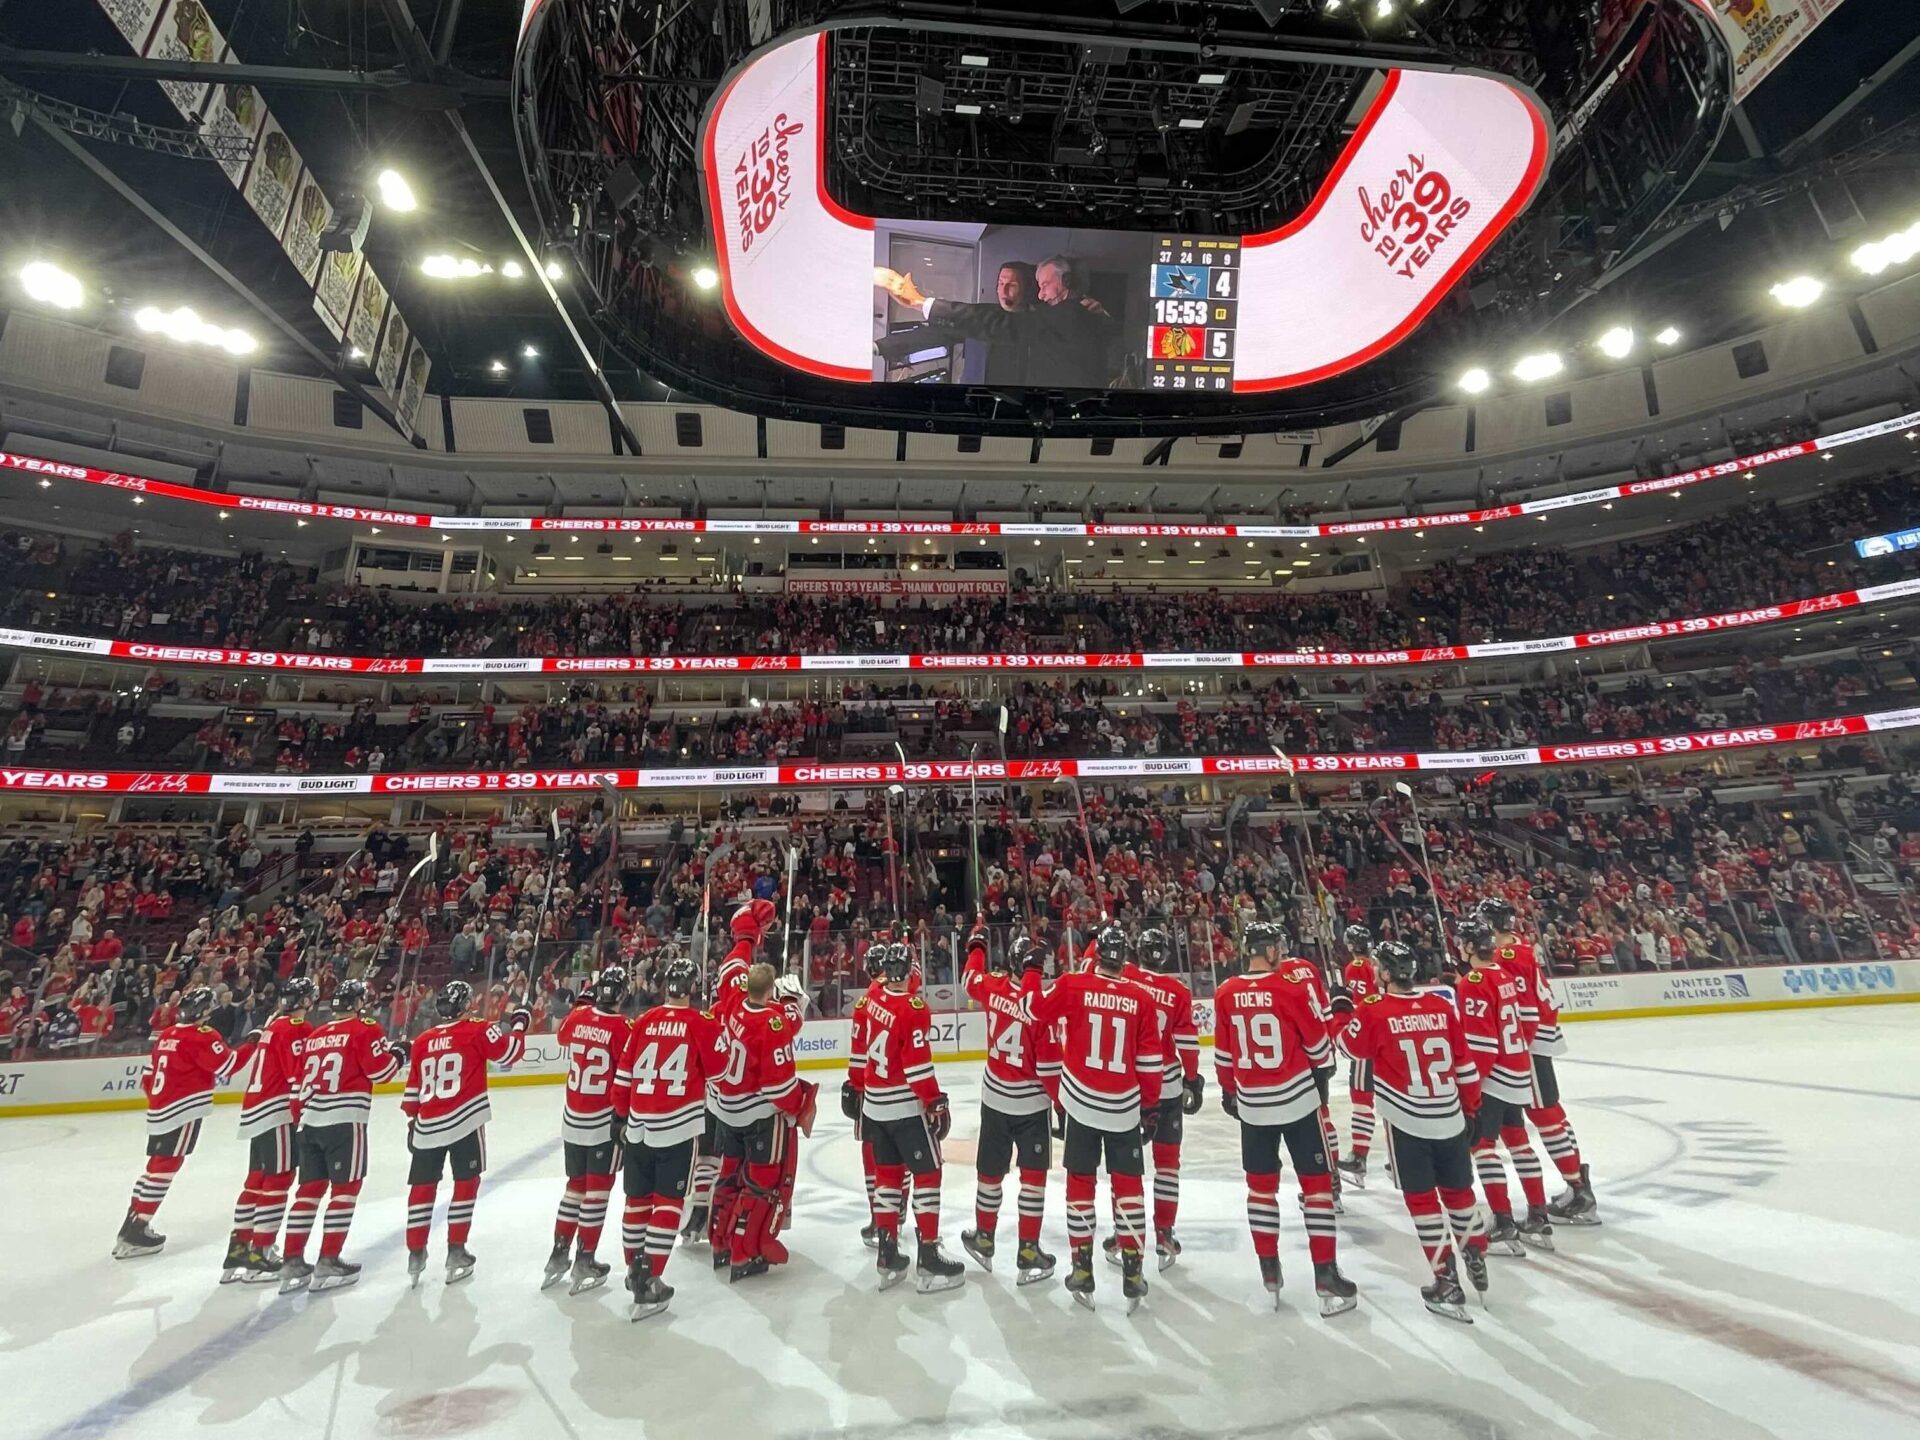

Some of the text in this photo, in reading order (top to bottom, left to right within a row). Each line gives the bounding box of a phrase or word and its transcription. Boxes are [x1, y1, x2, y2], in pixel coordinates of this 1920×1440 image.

[1737, 9, 1800, 75] CHAMPIONS
[774, 113, 803, 210] cheers
[751, 126, 776, 234] TO 39
[735, 151, 753, 253] YEARS
[1358, 154, 1424, 242] cheers
[1374, 171, 1451, 258] TO 39
[1396, 196, 1471, 279] YEARS
[1160, 251, 1231, 265] 37 24 16 9
[1215, 271, 1231, 297] 4
[1155, 299, 1208, 325] 15:53
[1212, 332, 1227, 357] 5
[1153, 375, 1225, 389] 32 29 12 10
[11, 456, 88, 479] YEARS
[1629, 446, 1802, 493] CHEERS 39 YEARS
[239, 498, 417, 524] CHEERS 39 YEARS
[541, 520, 695, 530] CHEERS 39 YEARS
[809, 523, 867, 532] CHEERS
[881, 523, 901, 531] 39
[904, 523, 952, 532] YEARS
[1093, 525, 1226, 535] CHEERS 39 YEARS
[1328, 522, 1386, 533] CHEERS
[1399, 518, 1419, 528] 39
[1421, 514, 1470, 526] YEARS
[789, 581, 1006, 593] CHEERS TO 39 YEARS THANK YOU PAT FOLEY
[1587, 625, 1662, 644] CHEERS
[1682, 618, 1709, 630] 39
[1711, 607, 1781, 626] YEARS
[33, 637, 93, 649] BUD LIGHT
[1525, 640, 1563, 650] BUD LIGHT
[129, 645, 223, 660] CHEERS
[229, 652, 241, 664] TO
[247, 652, 277, 665] 39
[281, 655, 353, 669] YEARS
[485, 661, 528, 670] BUD LIGHT
[556, 659, 739, 669] CHEERS TO 39 YEARS
[860, 658, 899, 666] BUD LIGHT
[921, 656, 988, 666] CHEERS
[1005, 655, 1029, 666] 39
[1032, 655, 1087, 666] YEARS
[1253, 655, 1315, 664] CHEERS
[1332, 654, 1353, 664] 39
[1356, 652, 1410, 664] YEARS
[1554, 728, 1777, 760] CHEERS TO 39 YEARS
[1144, 763, 1163, 771] BUD
[1164, 762, 1189, 771] LIGHT
[1215, 760, 1293, 772] CHEERS
[1313, 757, 1339, 770] 39
[1343, 757, 1406, 769] YEARS
[1481, 755, 1500, 763] BUD
[1501, 753, 1526, 762] LIGHT
[1, 771, 108, 788] YEARS
[715, 772, 735, 781] BUD
[736, 771, 764, 780] LIGHT
[794, 763, 1005, 780] CHEERS TO 39 YEARS
[300, 780, 323, 790] BUD
[325, 779, 354, 789] LIGHT
[385, 773, 619, 790] CHEERS TO 39 YEARS
[1570, 980, 1619, 990] GUARANTEE
[1672, 977, 1722, 988] UNITED
[1085, 992, 1138, 1014] RADDYSH
[1233, 992, 1272, 1008] TOEWS
[1572, 990, 1599, 999] TRUST
[1575, 999, 1593, 1008] LIFE
[1663, 988, 1725, 1000] AIRLINES
[1465, 998, 1487, 1017] 27
[428, 1037, 453, 1052] KANE
[572, 1025, 612, 1045] JOHNSON
[989, 1011, 1023, 1068] 14
[1086, 1013, 1126, 1073] 11
[1231, 1013, 1283, 1069] 19
[212, 1041, 224, 1054] 6
[371, 1036, 394, 1057] 23
[774, 1045, 792, 1066] 60
[152, 1055, 168, 1095] 6
[300, 1053, 343, 1100] 23
[568, 1043, 610, 1094] 52
[632, 1042, 688, 1095] 44
[1399, 1037, 1456, 1097] 12
[419, 1053, 463, 1103] 88
